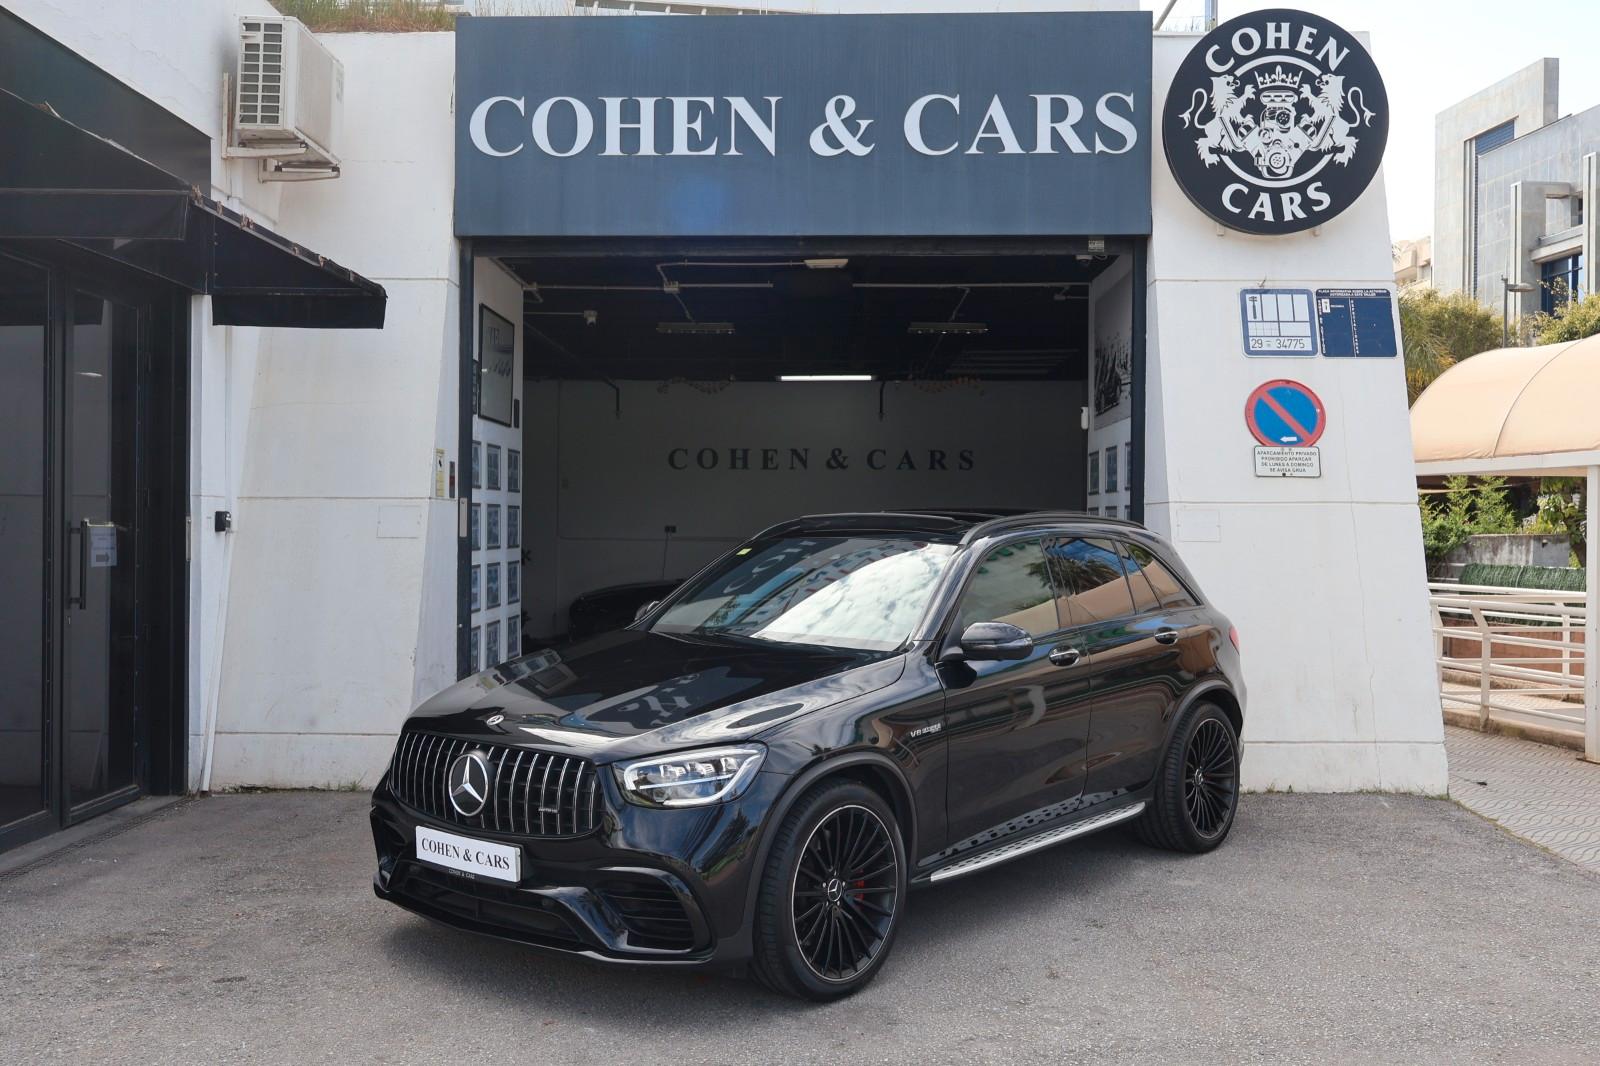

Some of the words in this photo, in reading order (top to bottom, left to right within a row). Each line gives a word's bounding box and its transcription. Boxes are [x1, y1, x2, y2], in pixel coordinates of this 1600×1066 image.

[1205, 22, 1350, 73] COHEN
[468, 95, 783, 158] COHEN
[808, 94, 876, 157] &
[903, 92, 1139, 156] CARS
[1221, 181, 1331, 222] CARS
[1251, 338, 1263, 349] 29
[1276, 338, 1305, 349] 34775
[668, 448, 810, 470] COHEN
[825, 448, 849, 470] &
[866, 449, 975, 471] CARS
[421, 837, 460, 859] COHEN
[463, 849, 472, 862] &
[476, 851, 510, 870] CARS
